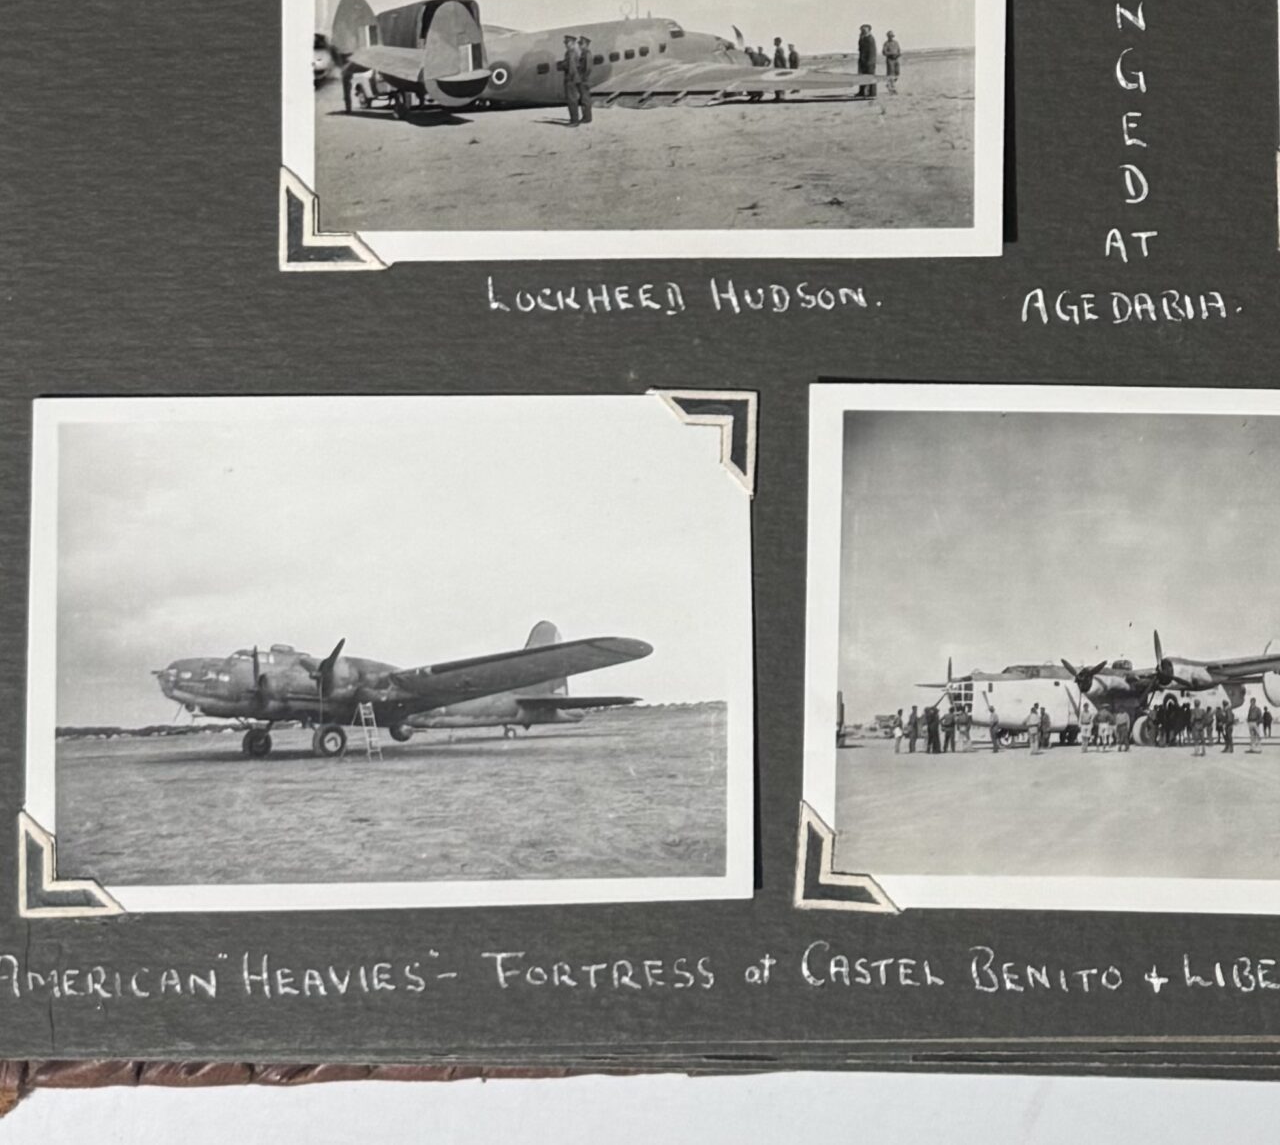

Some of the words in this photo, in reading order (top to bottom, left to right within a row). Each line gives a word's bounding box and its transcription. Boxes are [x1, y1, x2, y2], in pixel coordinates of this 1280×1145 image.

[1105, 228, 1158, 263] AT
[488, 276, 685, 315] LOCKHEED
[710, 278, 881, 314] HUDSON.
[481, 952, 714, 989] FORTRESS
[745, 954, 776, 984] at
[801, 940, 944, 986] CASTEL
[969, 946, 1122, 992] BENITO
